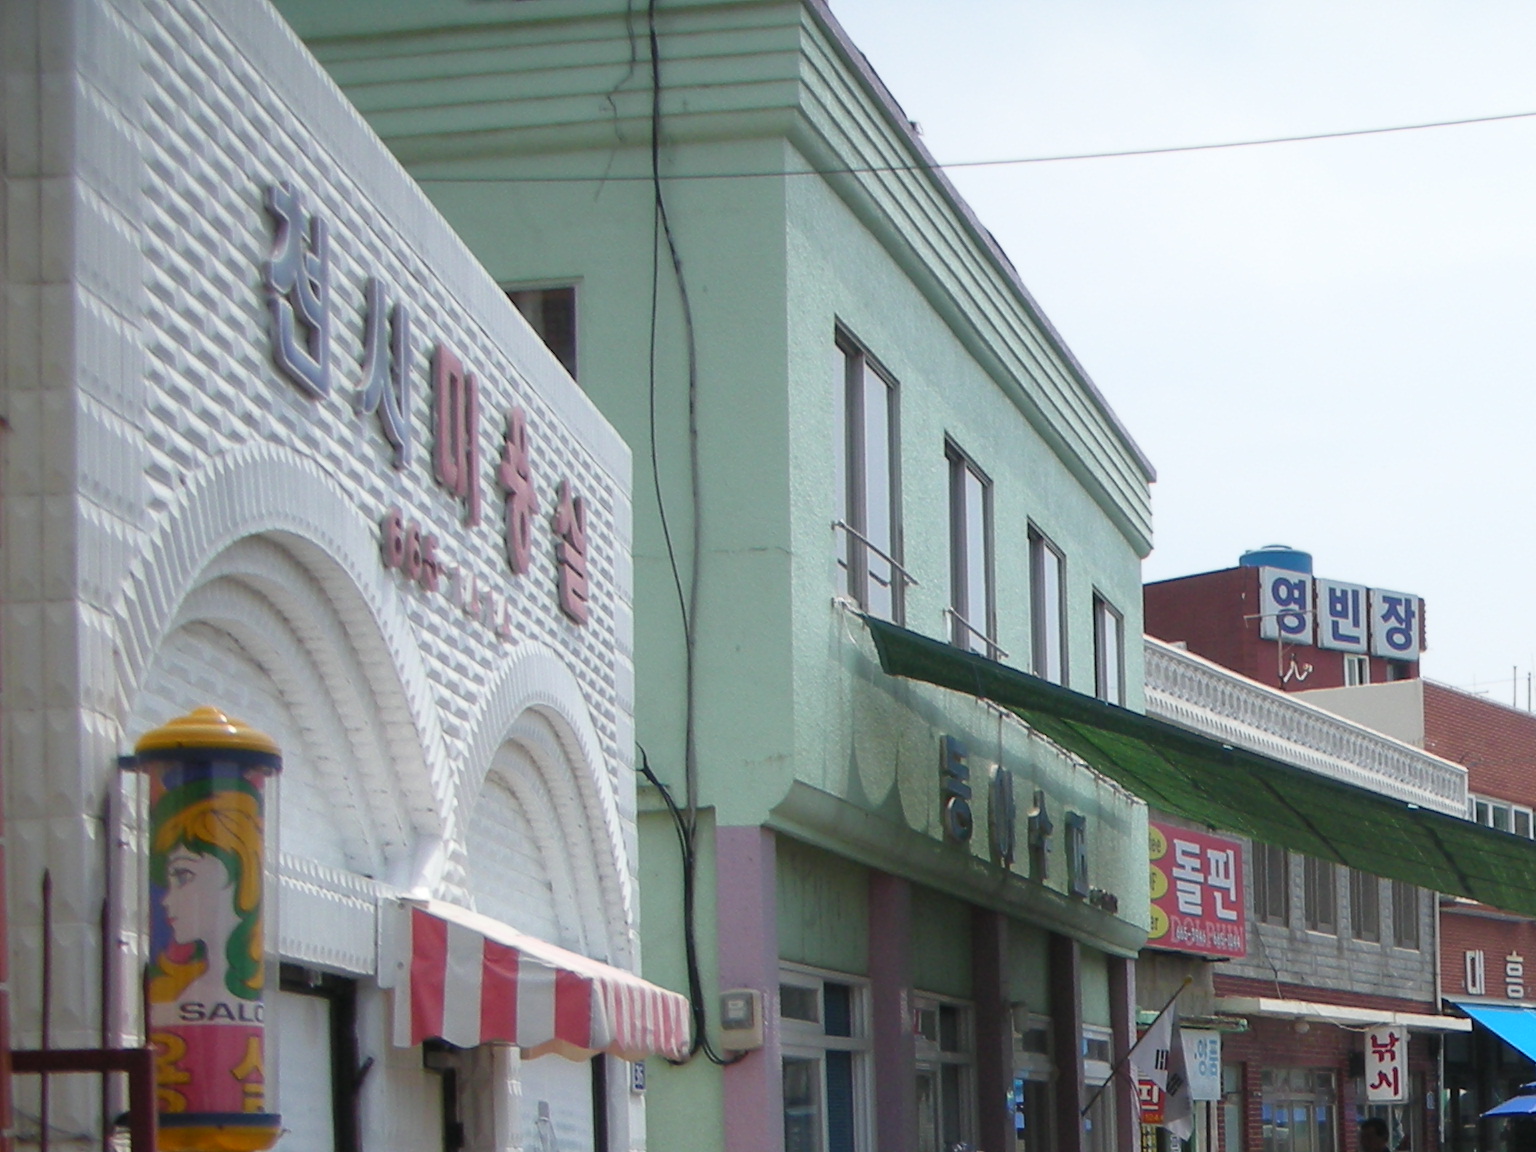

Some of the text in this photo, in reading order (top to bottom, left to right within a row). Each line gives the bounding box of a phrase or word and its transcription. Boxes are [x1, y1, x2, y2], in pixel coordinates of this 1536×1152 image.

[1271, 576, 1416, 651] 영빈장
[1172, 838, 1238, 921] 돌핀
[1369, 1030, 1400, 1097] 낚시
